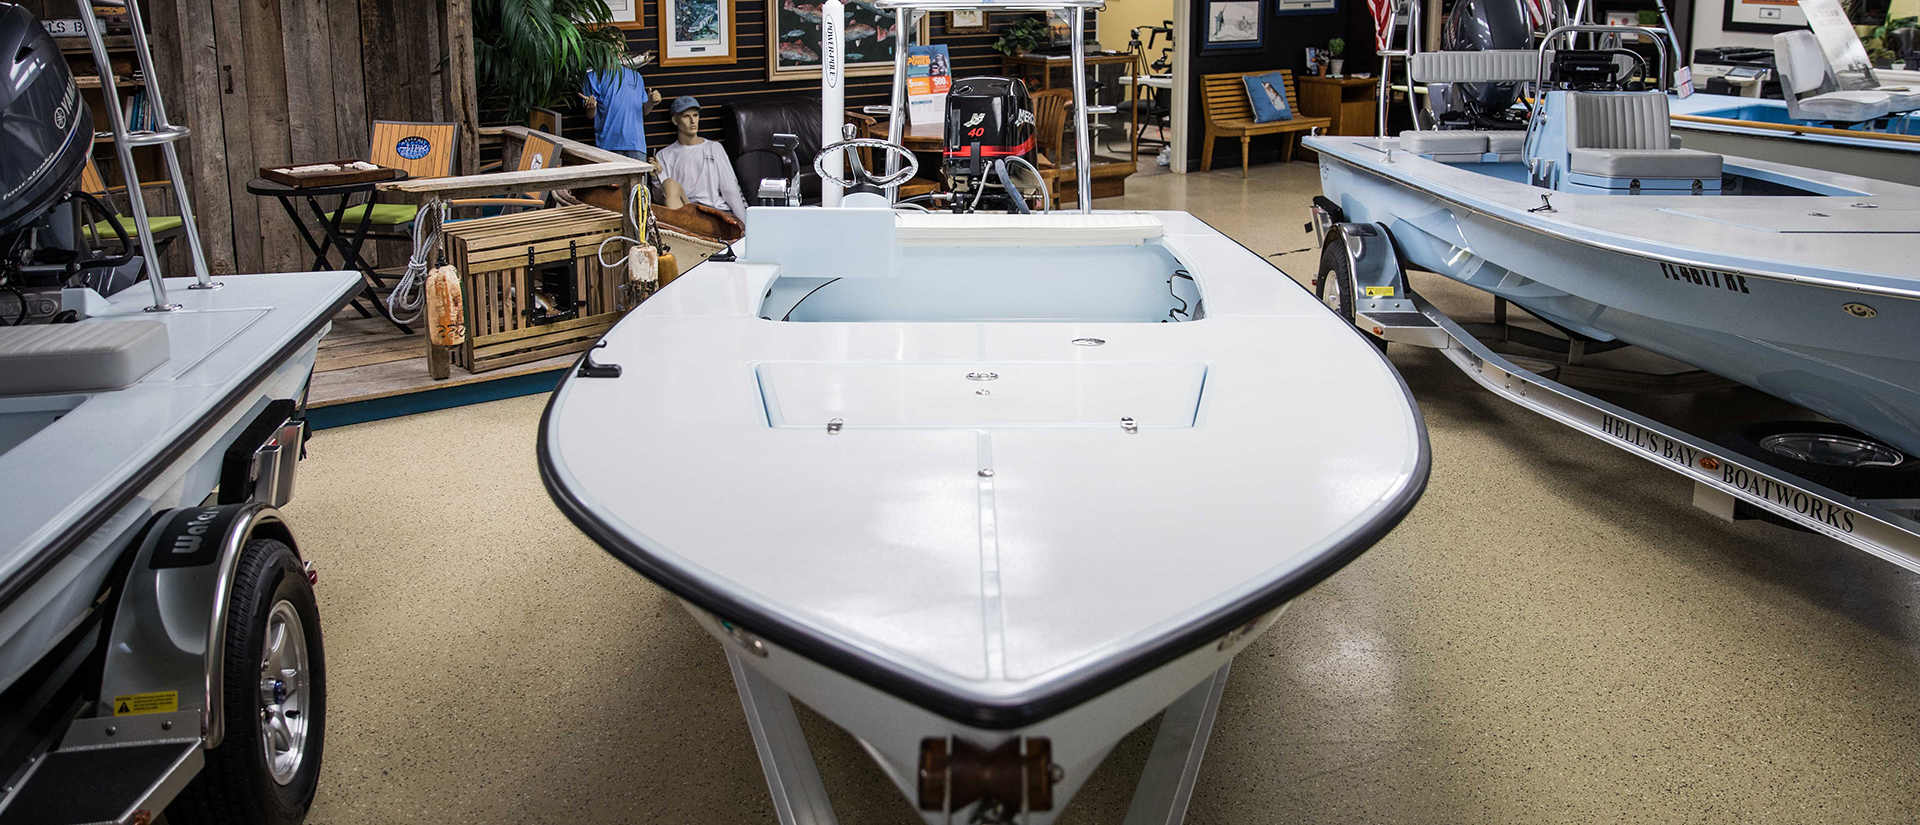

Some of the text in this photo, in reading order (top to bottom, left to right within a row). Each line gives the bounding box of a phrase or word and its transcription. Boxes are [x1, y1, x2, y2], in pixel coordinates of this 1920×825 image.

[827, 21, 836, 77] POWER-POLE
[967, 127, 985, 138] 40
[1601, 414, 1855, 534] HELL'S BAY BOATWORKS
